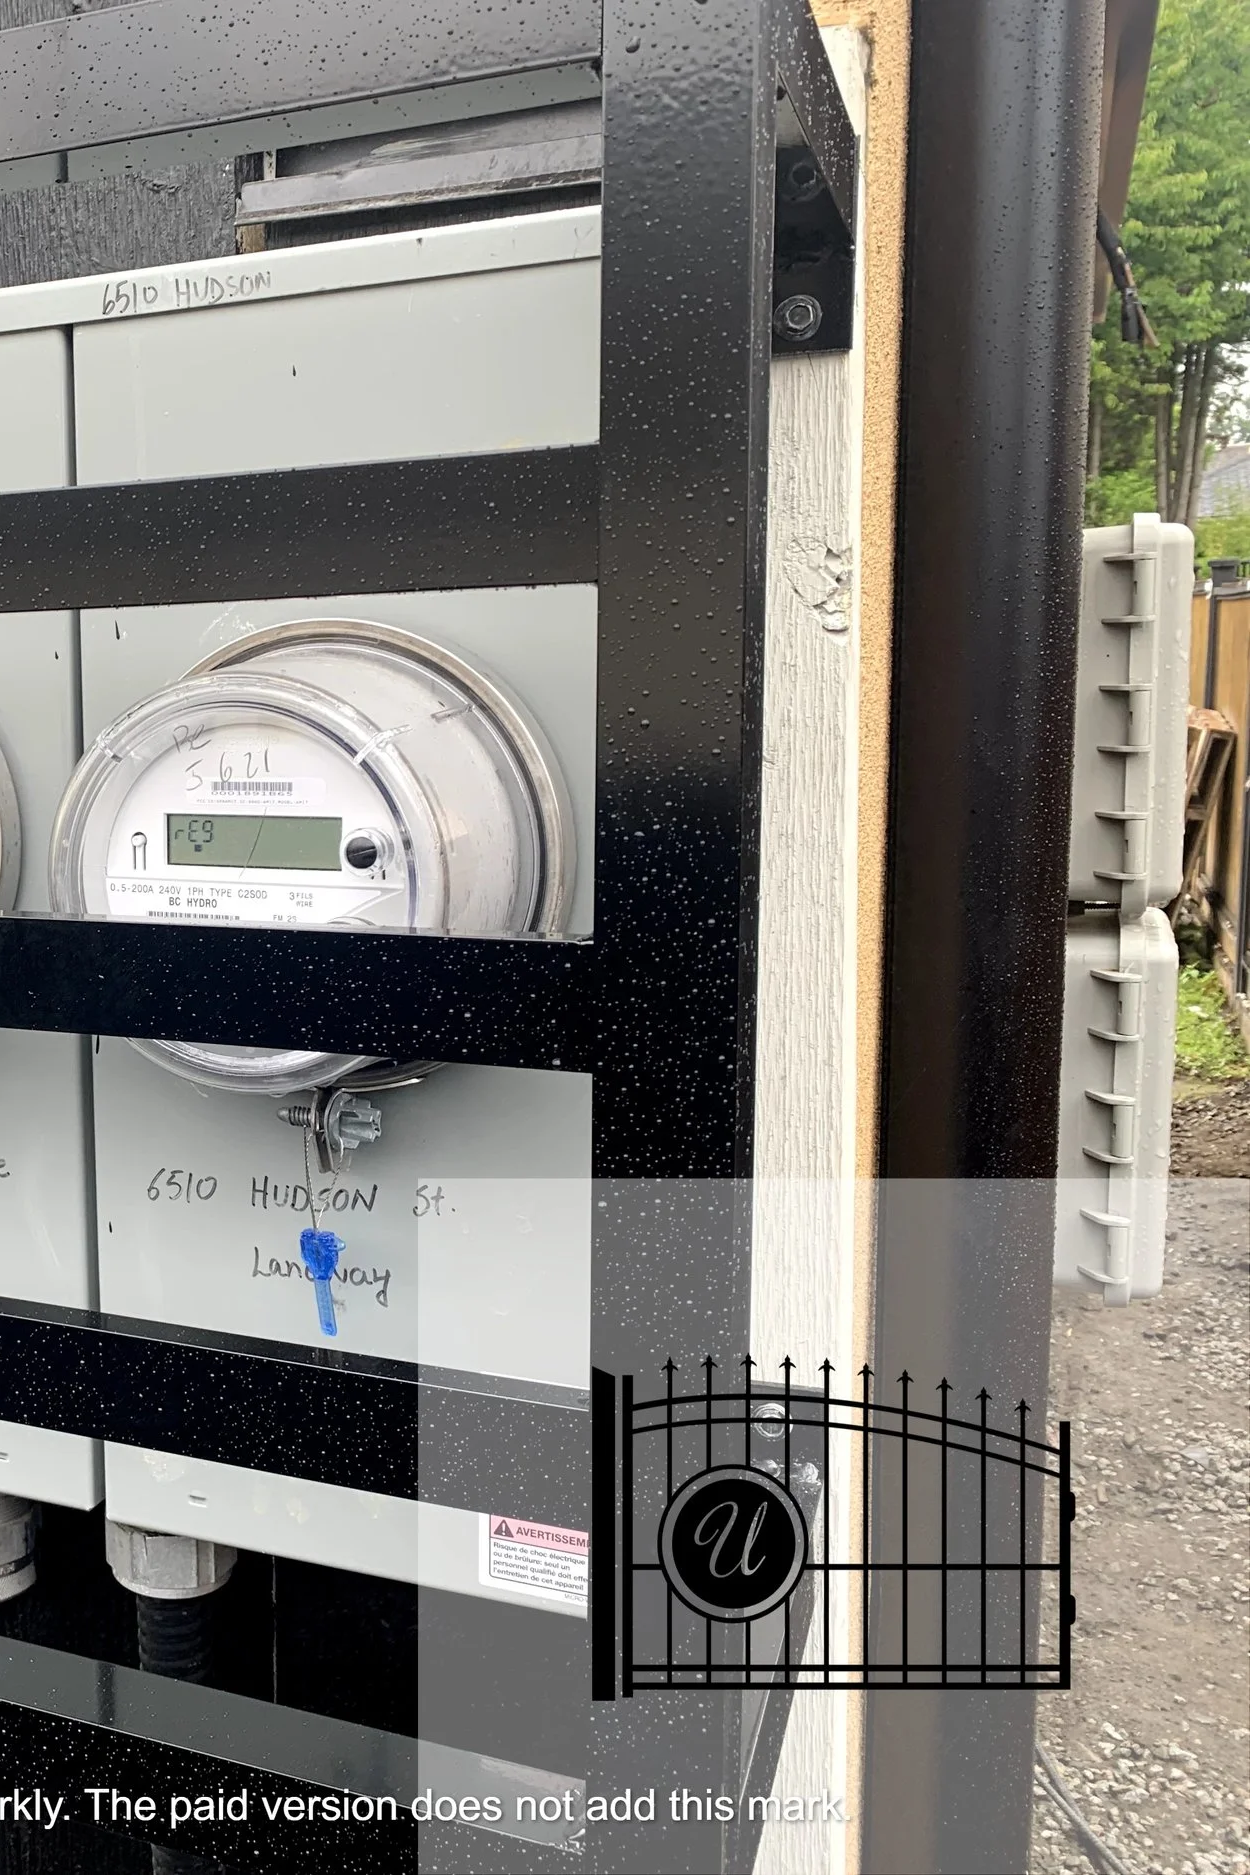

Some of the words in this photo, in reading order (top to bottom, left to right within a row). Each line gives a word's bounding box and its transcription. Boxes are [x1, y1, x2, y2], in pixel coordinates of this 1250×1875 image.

[102, 279, 158, 315] 6510
[174, 271, 271, 309] HUDSON
[109, 882, 154, 894] 0.5-200A
[158, 884, 182, 895] 240V
[187, 886, 204, 896] 1PH
[209, 887, 232, 898] TYPE
[289, 891, 295, 901] 3
[168, 896, 182, 907] BC
[186, 897, 218, 909] HYDRO
[147, 1168, 219, 1204] 6510
[251, 1175, 378, 1213] HUDSON
[412, 1184, 456, 1217] St.
[493, 1541, 518, 1554] Risque
[519, 1547, 528, 1555] de
[530, 1549, 547, 1558] choc
[493, 1559, 528, 1571] personnel
[558, 1571, 572, 1580] doit
[504, 1551, 513, 1560] de
[544, 1558, 559, 1568] seul
[561, 1563, 570, 1571] un
[493, 1567, 529, 1580] l'entretien
[530, 1574, 540, 1583] de
[541, 1577, 553, 1585] cet
[555, 1579, 584, 1592] appareil
